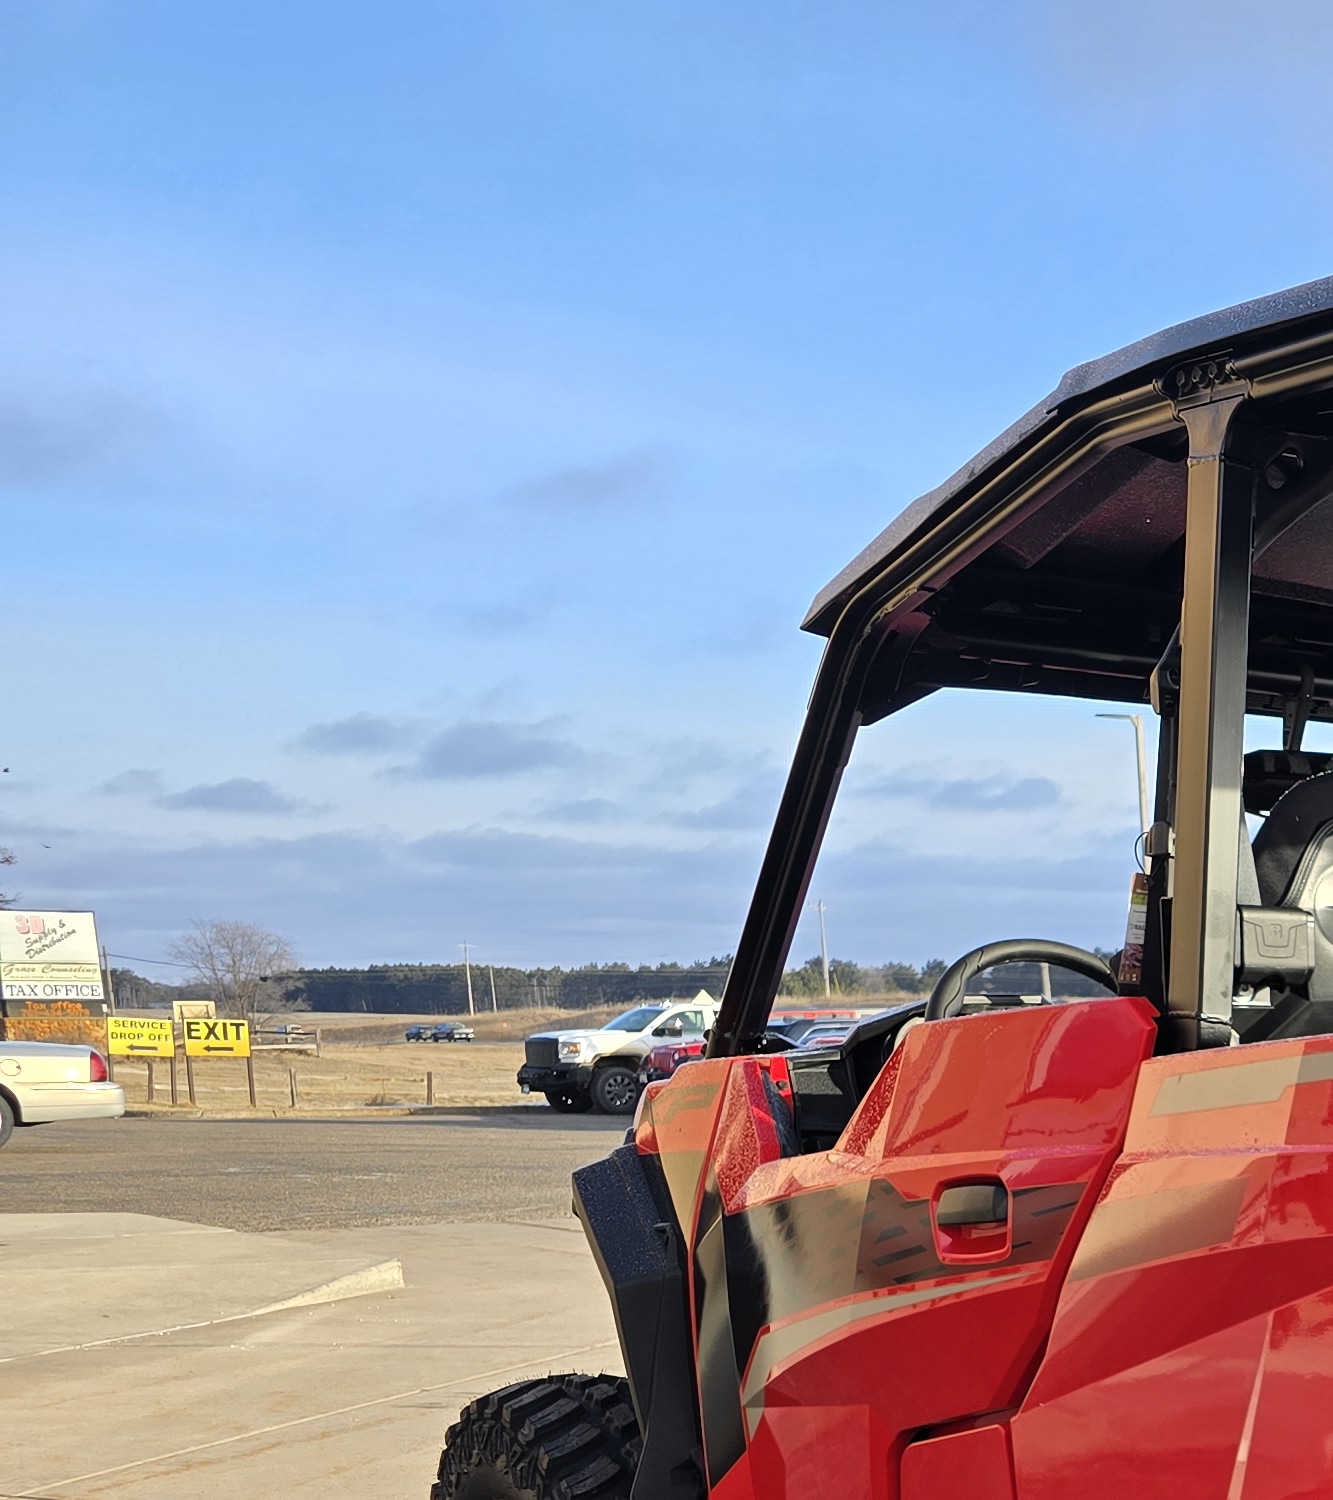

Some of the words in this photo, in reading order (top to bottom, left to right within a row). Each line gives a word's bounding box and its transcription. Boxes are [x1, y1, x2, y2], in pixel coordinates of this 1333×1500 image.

[15, 914, 45, 934] 3D
[6, 984, 38, 997] TAX
[43, 984, 101, 997] OFFICE
[113, 1020, 167, 1030] SERVICE
[186, 1021, 245, 1041] EXIT
[110, 1031, 144, 1041] DROP
[148, 1033, 171, 1042] OFF
